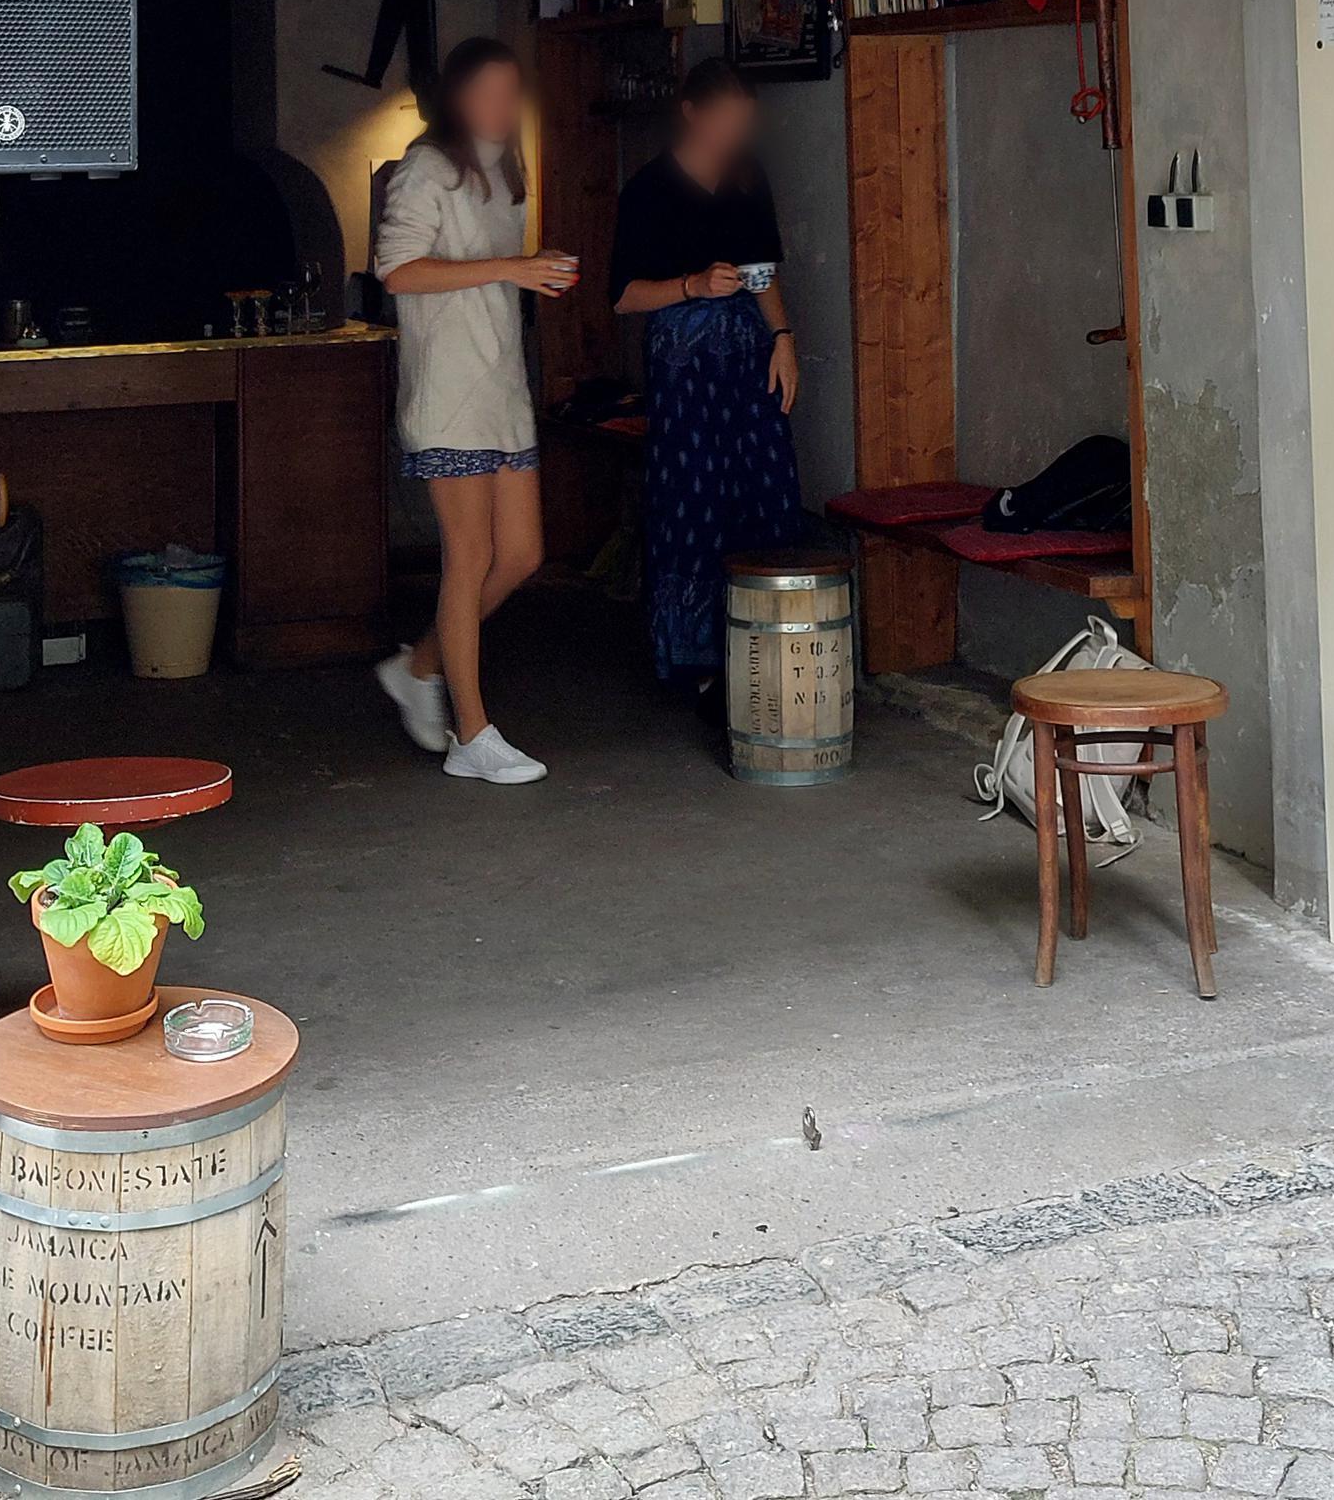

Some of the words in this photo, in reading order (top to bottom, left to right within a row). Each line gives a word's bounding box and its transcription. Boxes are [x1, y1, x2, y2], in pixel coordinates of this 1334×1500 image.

[793, 666, 805, 679] T
[794, 691, 806, 705] N
[10, 1155, 107, 1191] BARON
[110, 1148, 227, 1194] ESTATE
[7, 1224, 129, 1262] JAMAICA
[27, 1274, 187, 1308] MOUNTAIN
[7, 1311, 114, 1352] COFFEE
[49, 1449, 90, 1472] OF
